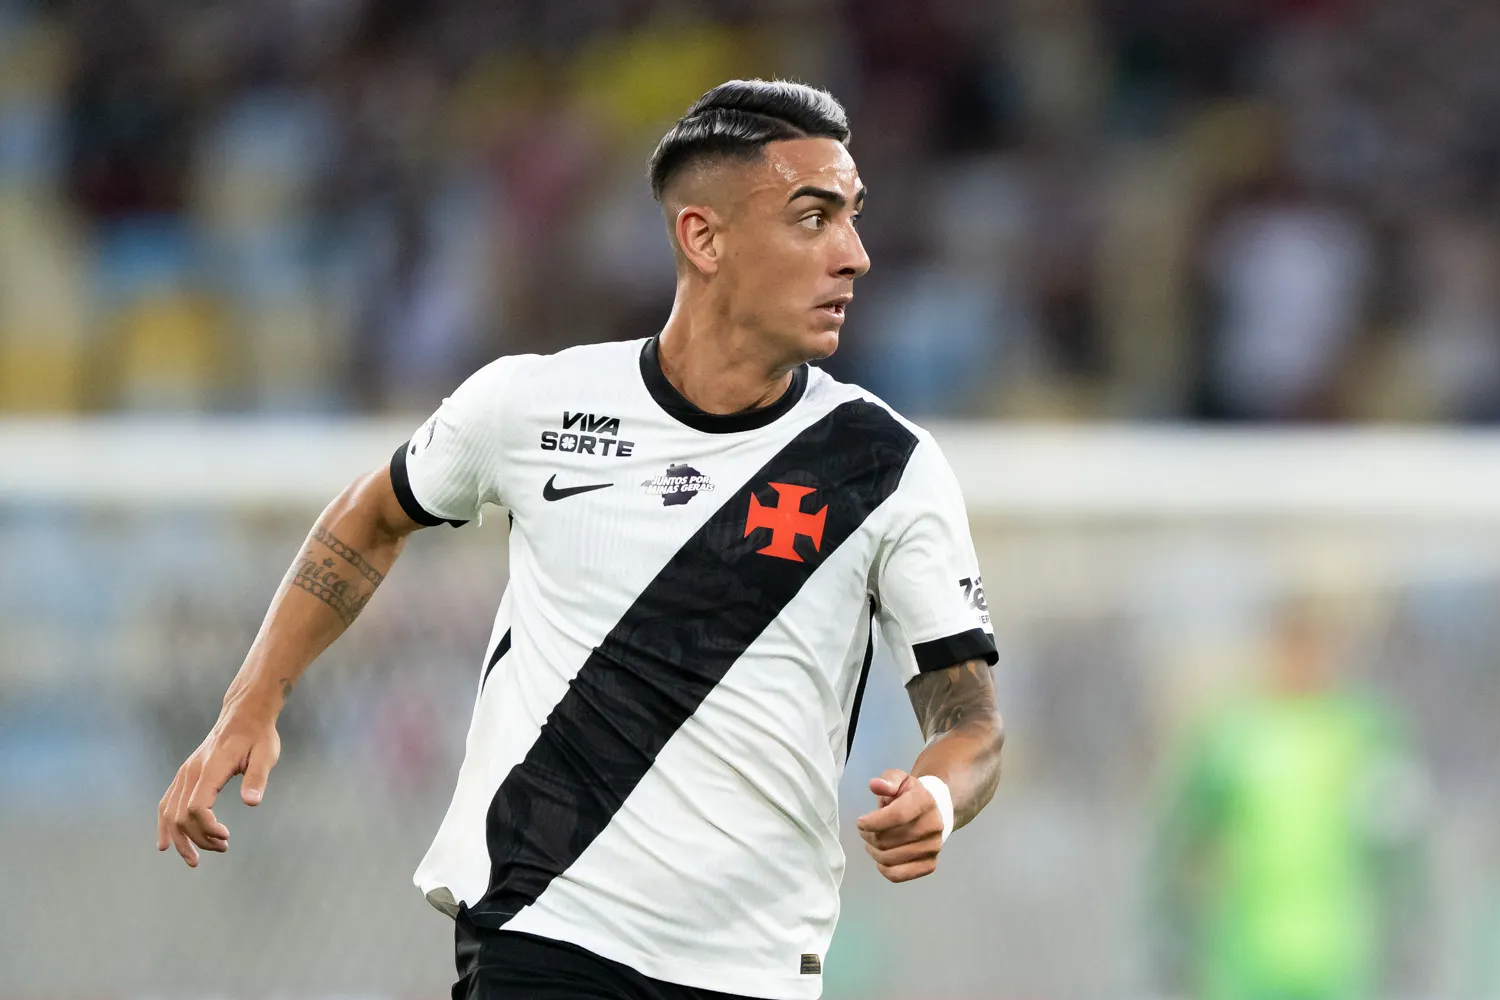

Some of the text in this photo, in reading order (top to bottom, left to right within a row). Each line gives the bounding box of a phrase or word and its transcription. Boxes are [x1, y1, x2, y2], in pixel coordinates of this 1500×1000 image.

[563, 411, 620, 436] VIVA
[541, 431, 634, 457] SORTE
[646, 483, 715, 495] MINAS GERAIS
[652, 475, 712, 486] JUNTOS POR
